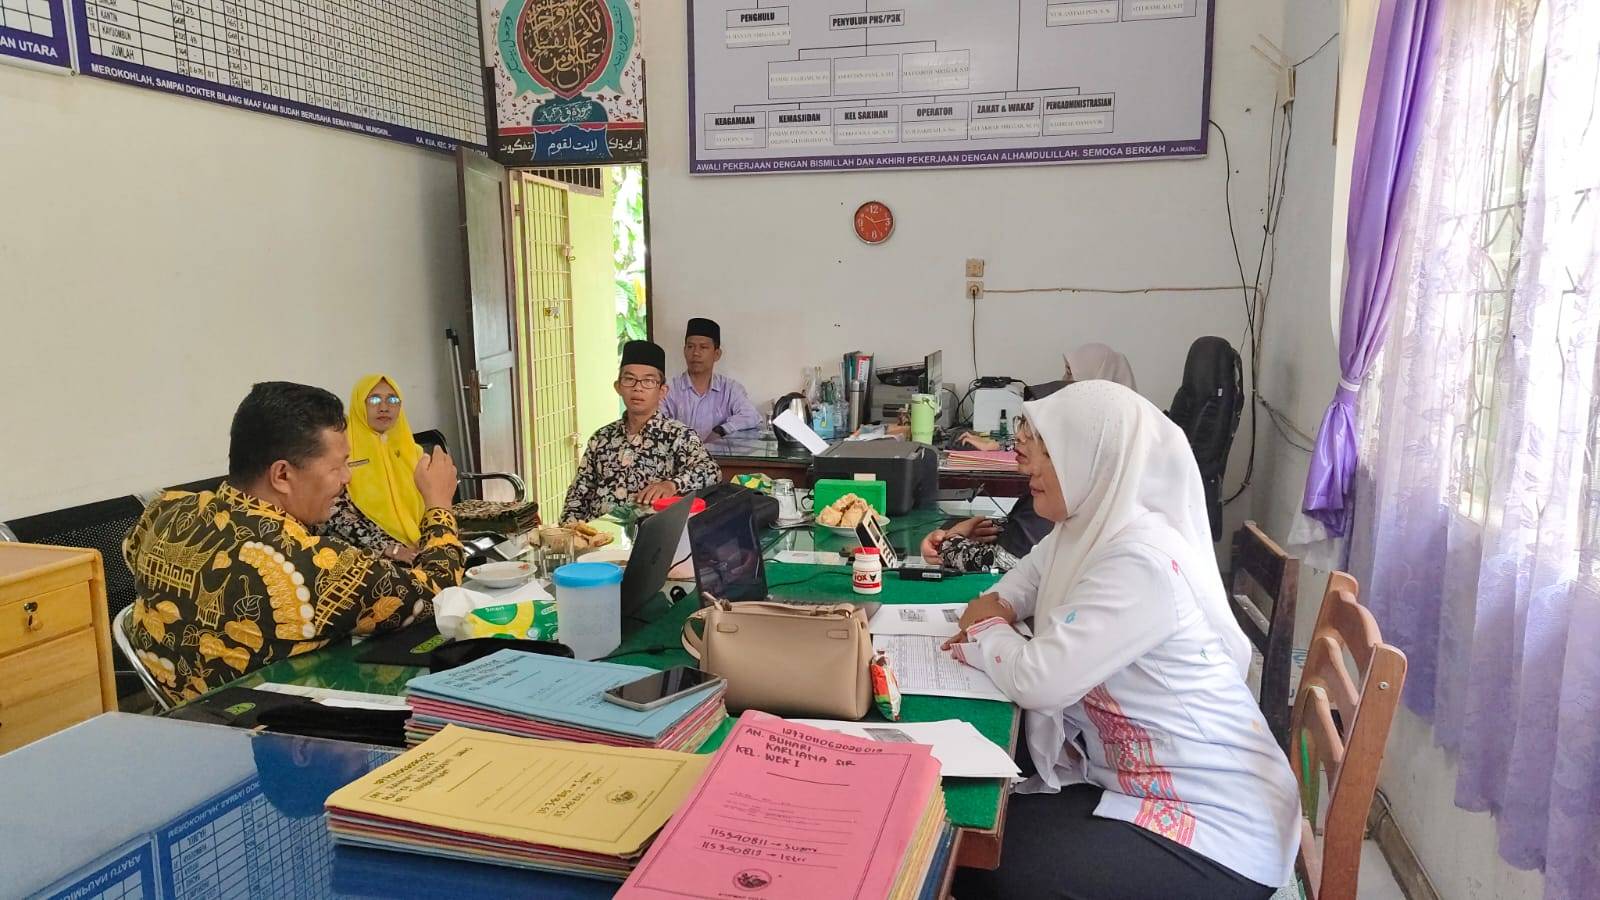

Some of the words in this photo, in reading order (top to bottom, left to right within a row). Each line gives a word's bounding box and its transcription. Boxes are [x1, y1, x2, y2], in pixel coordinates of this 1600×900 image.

[740, 12, 775, 23] PENGHULU
[832, 15, 868, 27] PENYULUH
[869, 13, 901, 25] PNS/P3K
[18, 39, 59, 59] UTARA
[111, 44, 135, 60] JUMLAH
[90, 62, 155, 87] MEROKOHLAH,
[155, 77, 185, 92] SAMPAI
[185, 84, 216, 99] DOKTER
[216, 91, 242, 104] BILANG
[242, 97, 262, 109] MAAF
[262, 101, 279, 112] KAMI
[279, 105, 300, 117] SUDAH
[300, 110, 332, 125] BERUSAHA
[976, 104, 1000, 114] ZAKAT
[1000, 104, 1007, 113] &
[1008, 102, 1035, 112] WAKAF
[1045, 97, 1112, 110] PENGADMINISTRASIAN
[844, 111, 857, 121] KEL
[857, 110, 888, 120] SAKINAH
[916, 107, 953, 117] OPERATOR
[714, 116, 755, 126] KEAGAMAAN
[778, 113, 821, 124] KEMASJIDAN
[695, 163, 721, 171] AWALI
[722, 161, 772, 171] PEKERJAAN
[773, 160, 808, 169] DENGAN
[810, 157, 855, 168] BISMILLAH
[856, 157, 874, 166] DAN
[876, 156, 905, 165] AKHIRI
[906, 154, 959, 165] PEKERJAAN
[961, 153, 999, 162] DENGAN
[1082, 147, 1123, 157] SEMOGA
[1125, 145, 1166, 155] BERKAH
[870, 205, 879, 214] 12
[745, 727, 764, 738] AN.
[768, 734, 812, 752] BUHARI
[765, 742, 828, 763] KARLIANA
[765, 753, 790, 765] WEK
